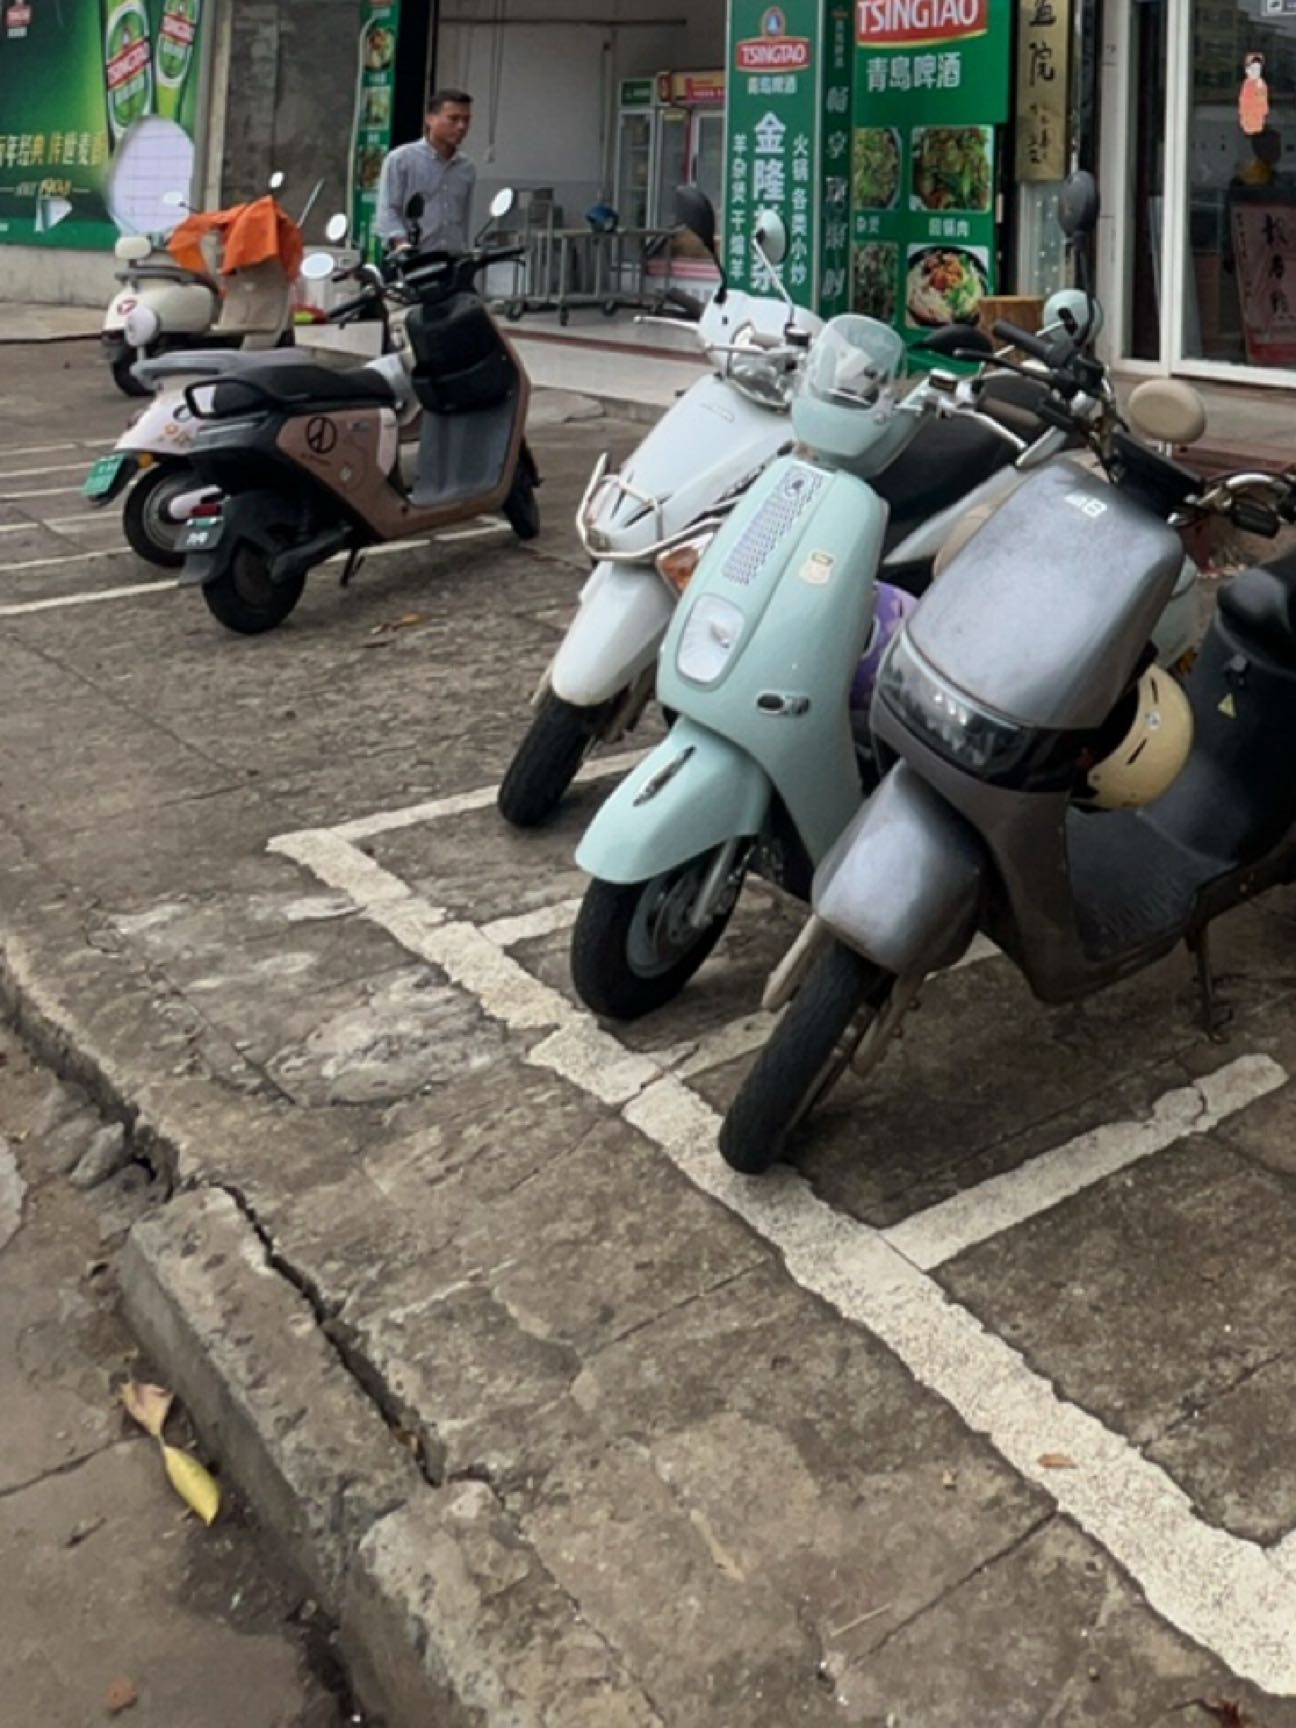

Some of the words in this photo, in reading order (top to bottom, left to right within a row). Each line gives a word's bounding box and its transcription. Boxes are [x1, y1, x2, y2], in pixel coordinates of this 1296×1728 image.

[741, 43, 807, 66] TSINGTAO
[866, 51, 961, 92] 青岛啤酒
[748, 75, 797, 95] 青岛啤酒
